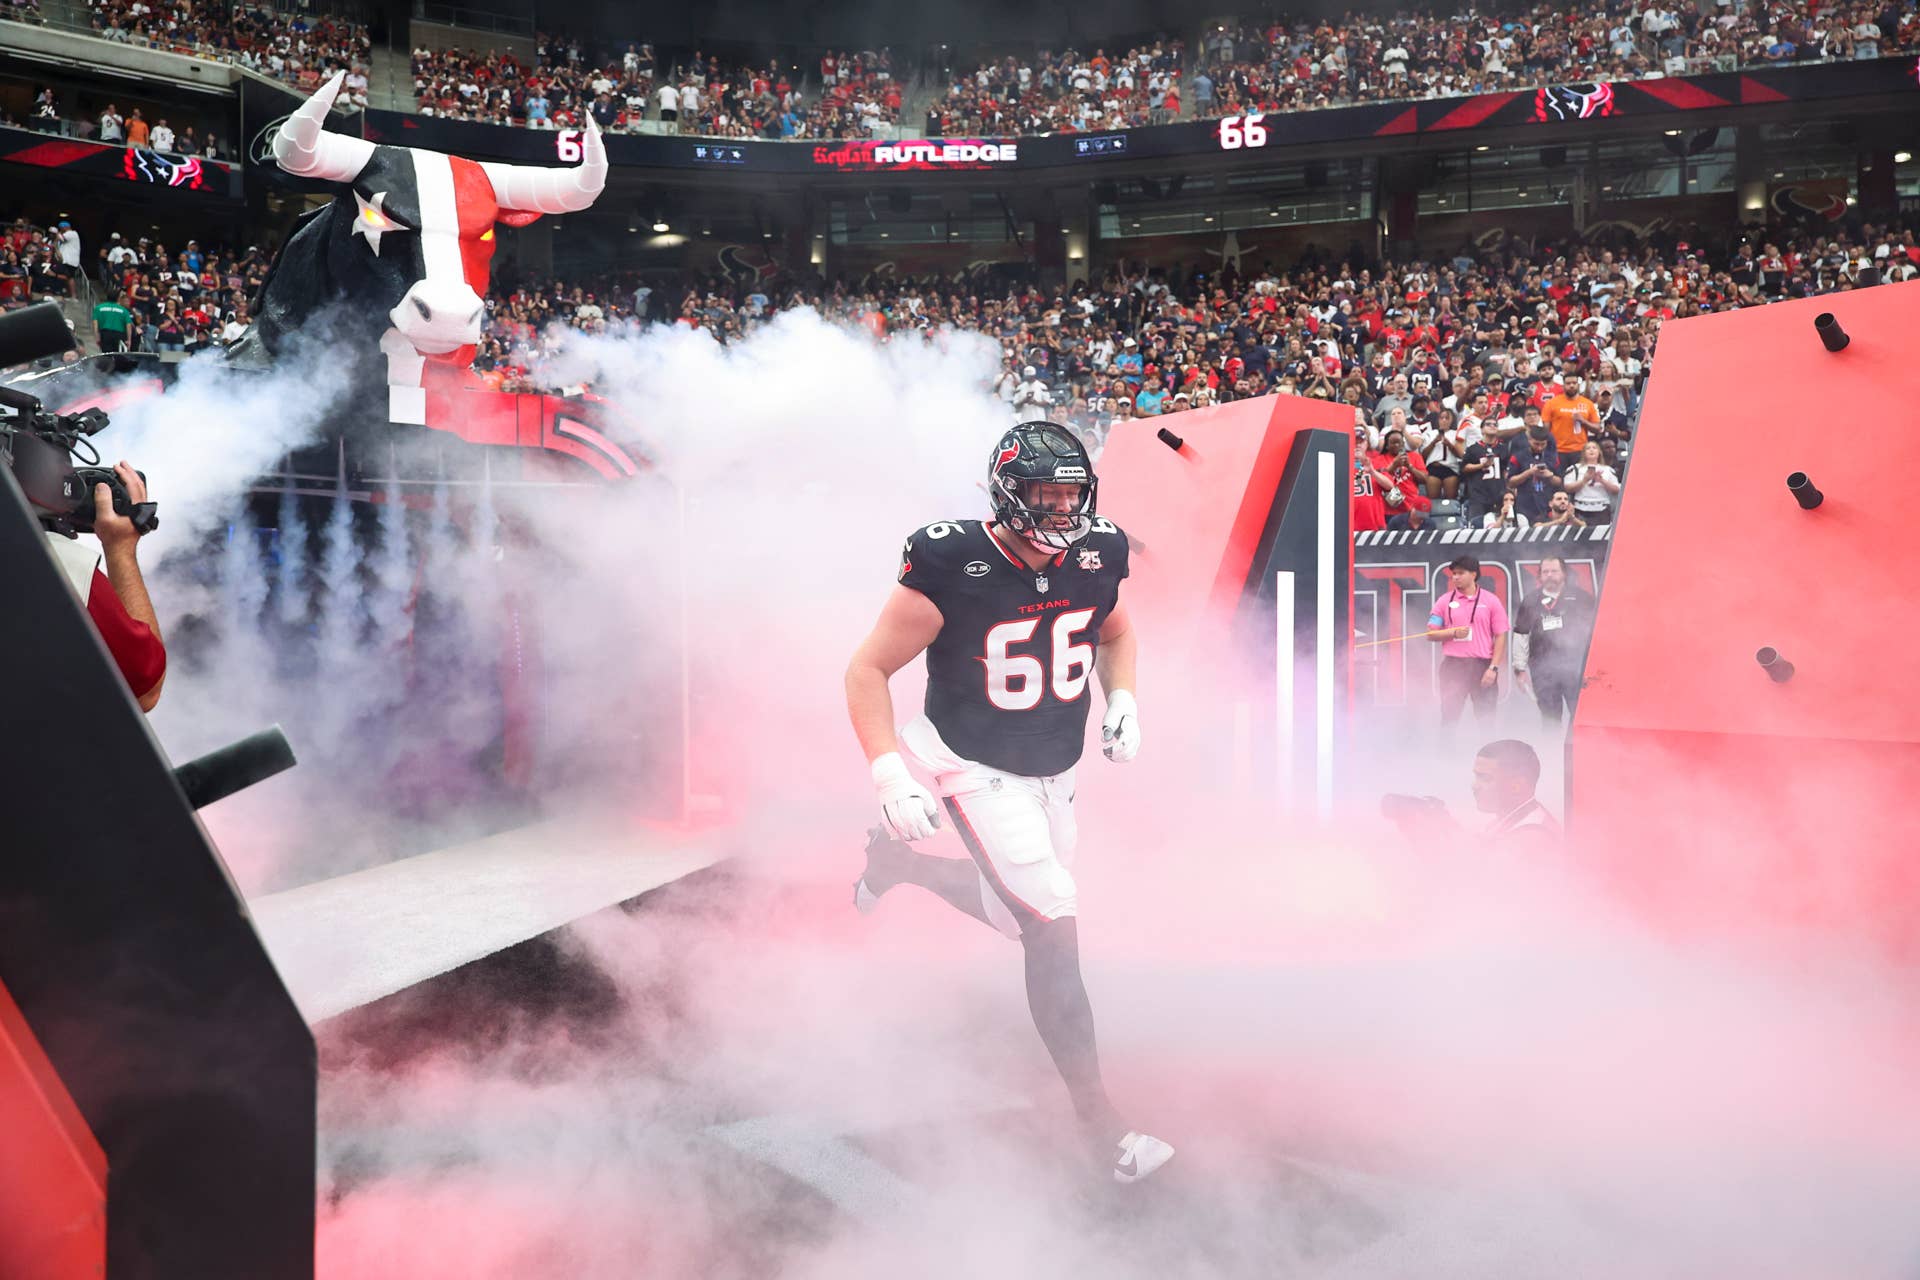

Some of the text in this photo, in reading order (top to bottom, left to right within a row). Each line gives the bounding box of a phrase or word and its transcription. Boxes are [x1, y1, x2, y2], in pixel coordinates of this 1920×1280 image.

[1219, 114, 1267, 150] 66
[874, 144, 1018, 163] RUTLEDGE
[1018, 599, 1071, 614] TEXANS
[973, 606, 1097, 712] 66
